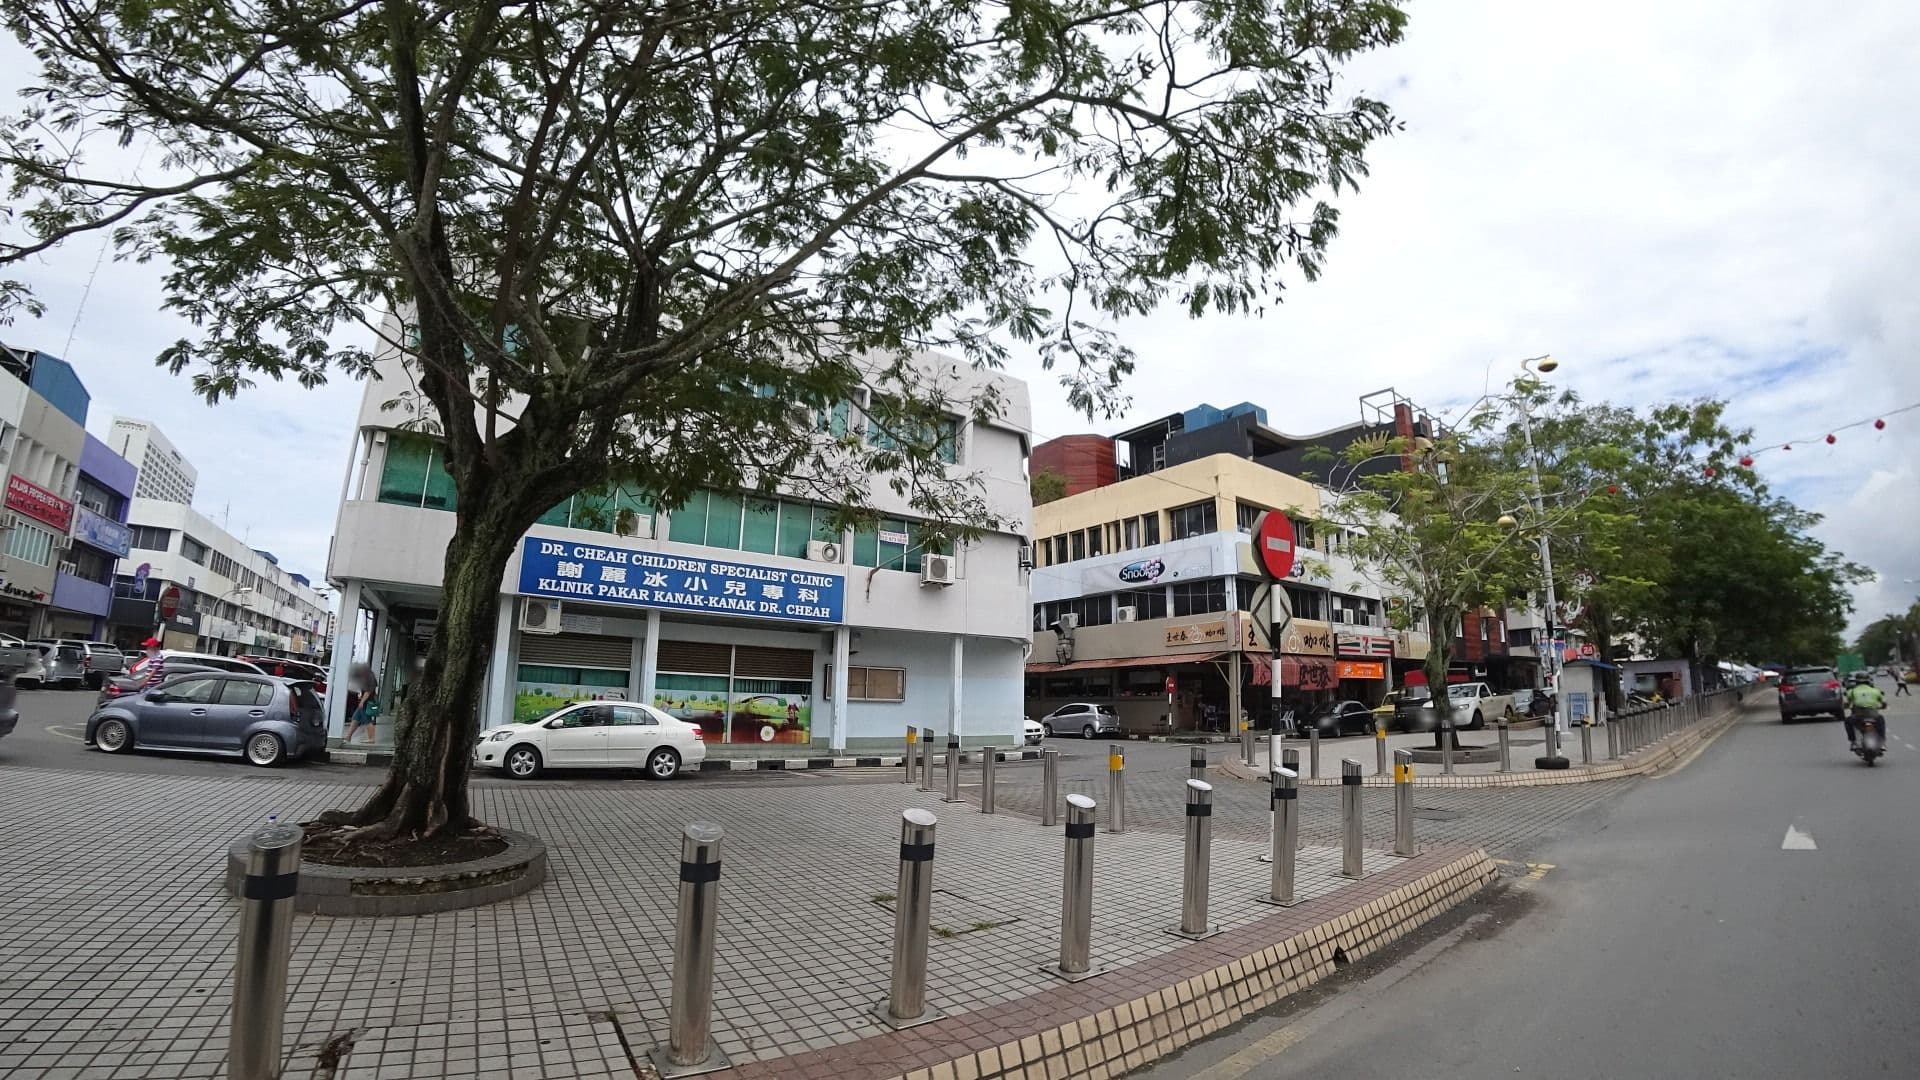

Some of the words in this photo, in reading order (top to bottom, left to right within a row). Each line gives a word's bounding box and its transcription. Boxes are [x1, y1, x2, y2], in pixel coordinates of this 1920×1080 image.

[540, 542, 568, 557] DR.
[573, 546, 628, 564] CHEAH
[631, 554, 707, 574] CHILDREN
[710, 563, 788, 583] SPECIALIST
[790, 573, 833, 588] CLINIC
[538, 578, 594, 595] KLINIK
[598, 584, 650, 601] PAKAR
[654, 590, 756, 612] KANAK-KANAK
[759, 601, 782, 614] DR.
[786, 604, 830, 618] CHEAH
